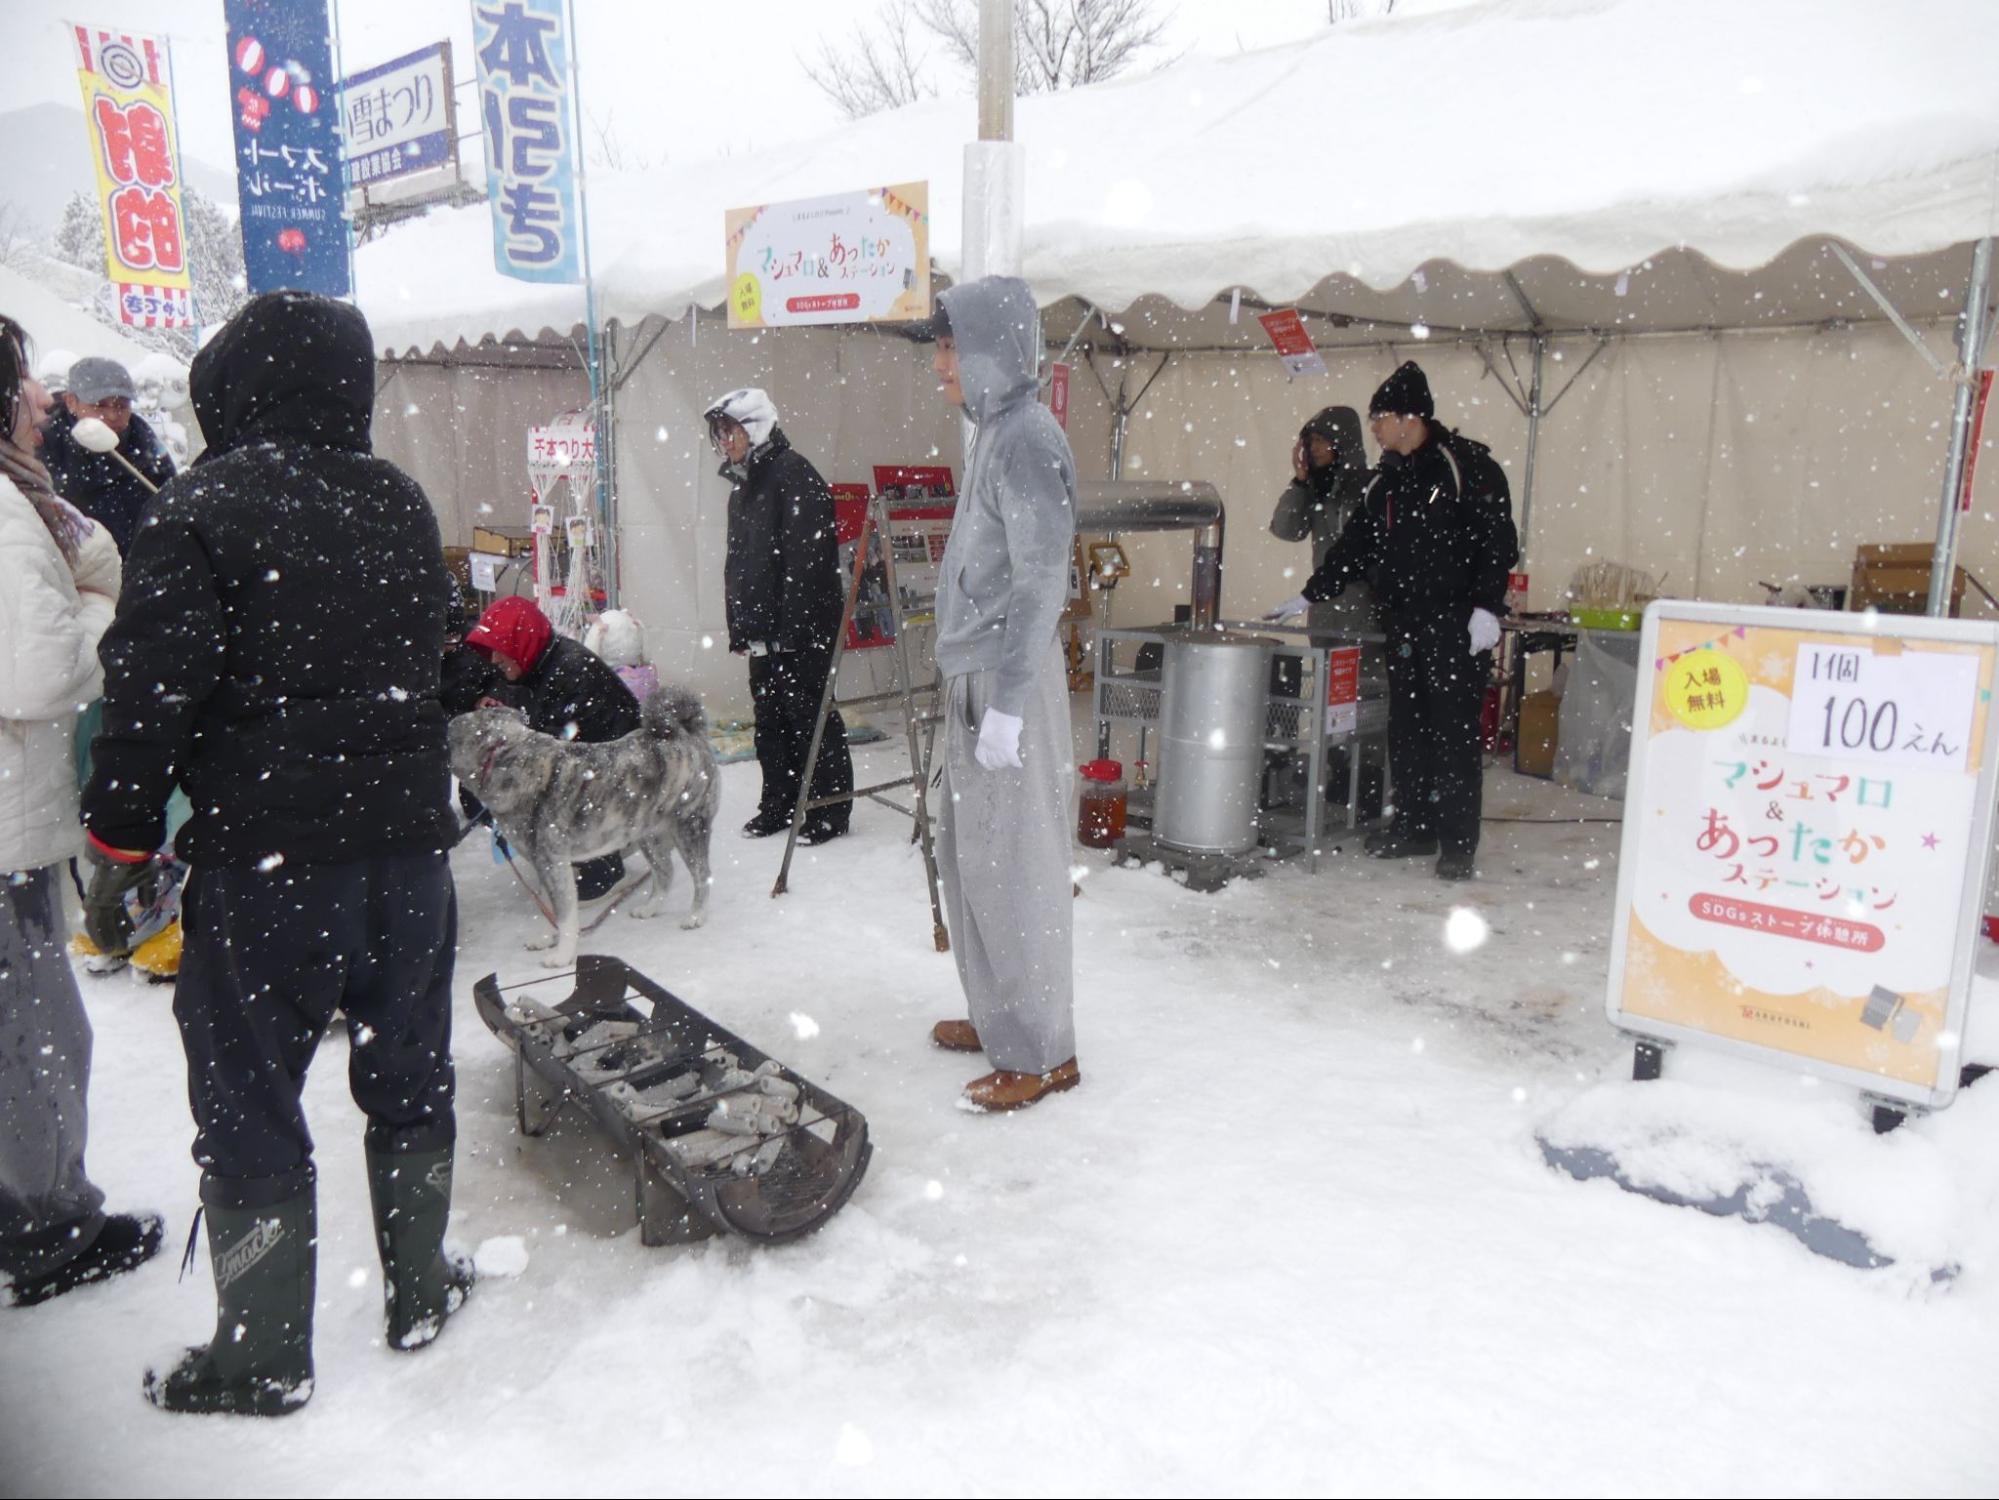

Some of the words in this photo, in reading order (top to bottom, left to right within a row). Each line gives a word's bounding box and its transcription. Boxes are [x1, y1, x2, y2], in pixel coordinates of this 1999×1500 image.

[347, 73, 434, 146] 雪まつり
[1683, 667, 1722, 689] 入場
[1686, 691, 1726, 712] 無料
[1712, 758, 1893, 809] マシュマロ
[1765, 799, 1785, 822] &
[1696, 806, 1887, 865] あったか
[1721, 862, 1898, 911] ステーション
